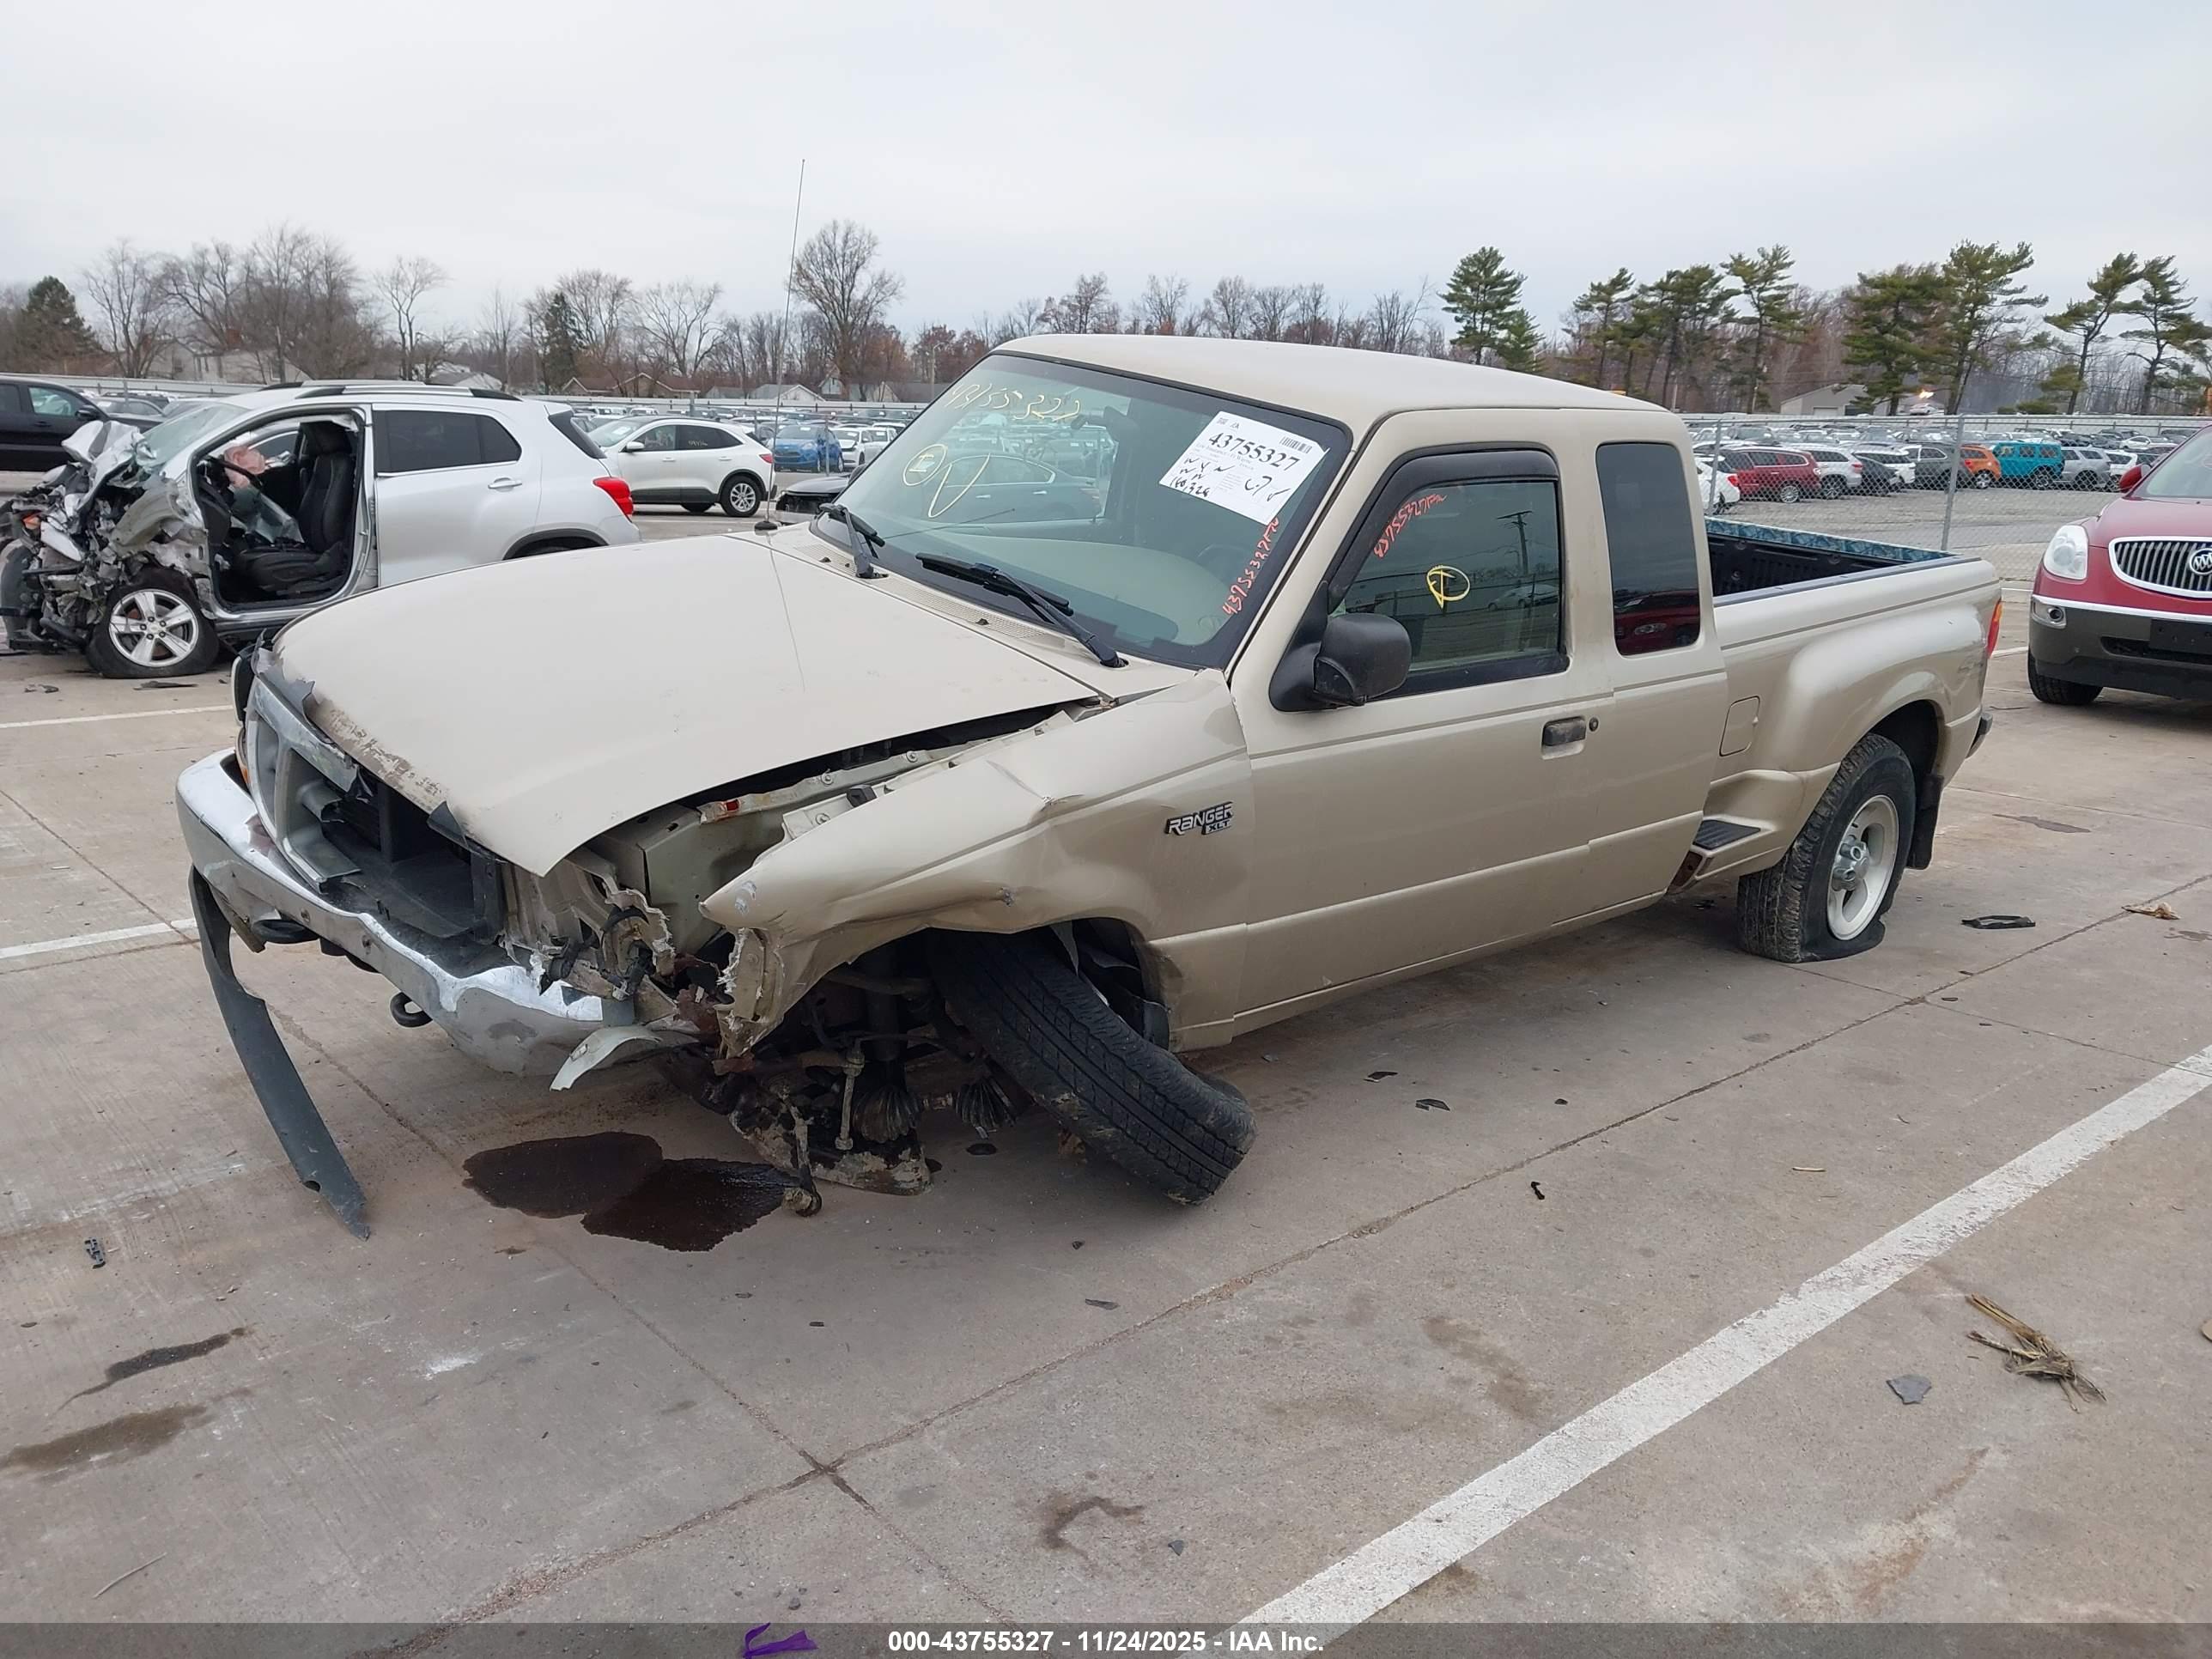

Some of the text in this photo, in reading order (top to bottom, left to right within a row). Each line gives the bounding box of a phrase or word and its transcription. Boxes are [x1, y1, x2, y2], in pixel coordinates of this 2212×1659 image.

[1208, 432, 1300, 471] 43755327
[1164, 800, 1234, 836] RANGER
[1208, 820, 1231, 833] XLT
